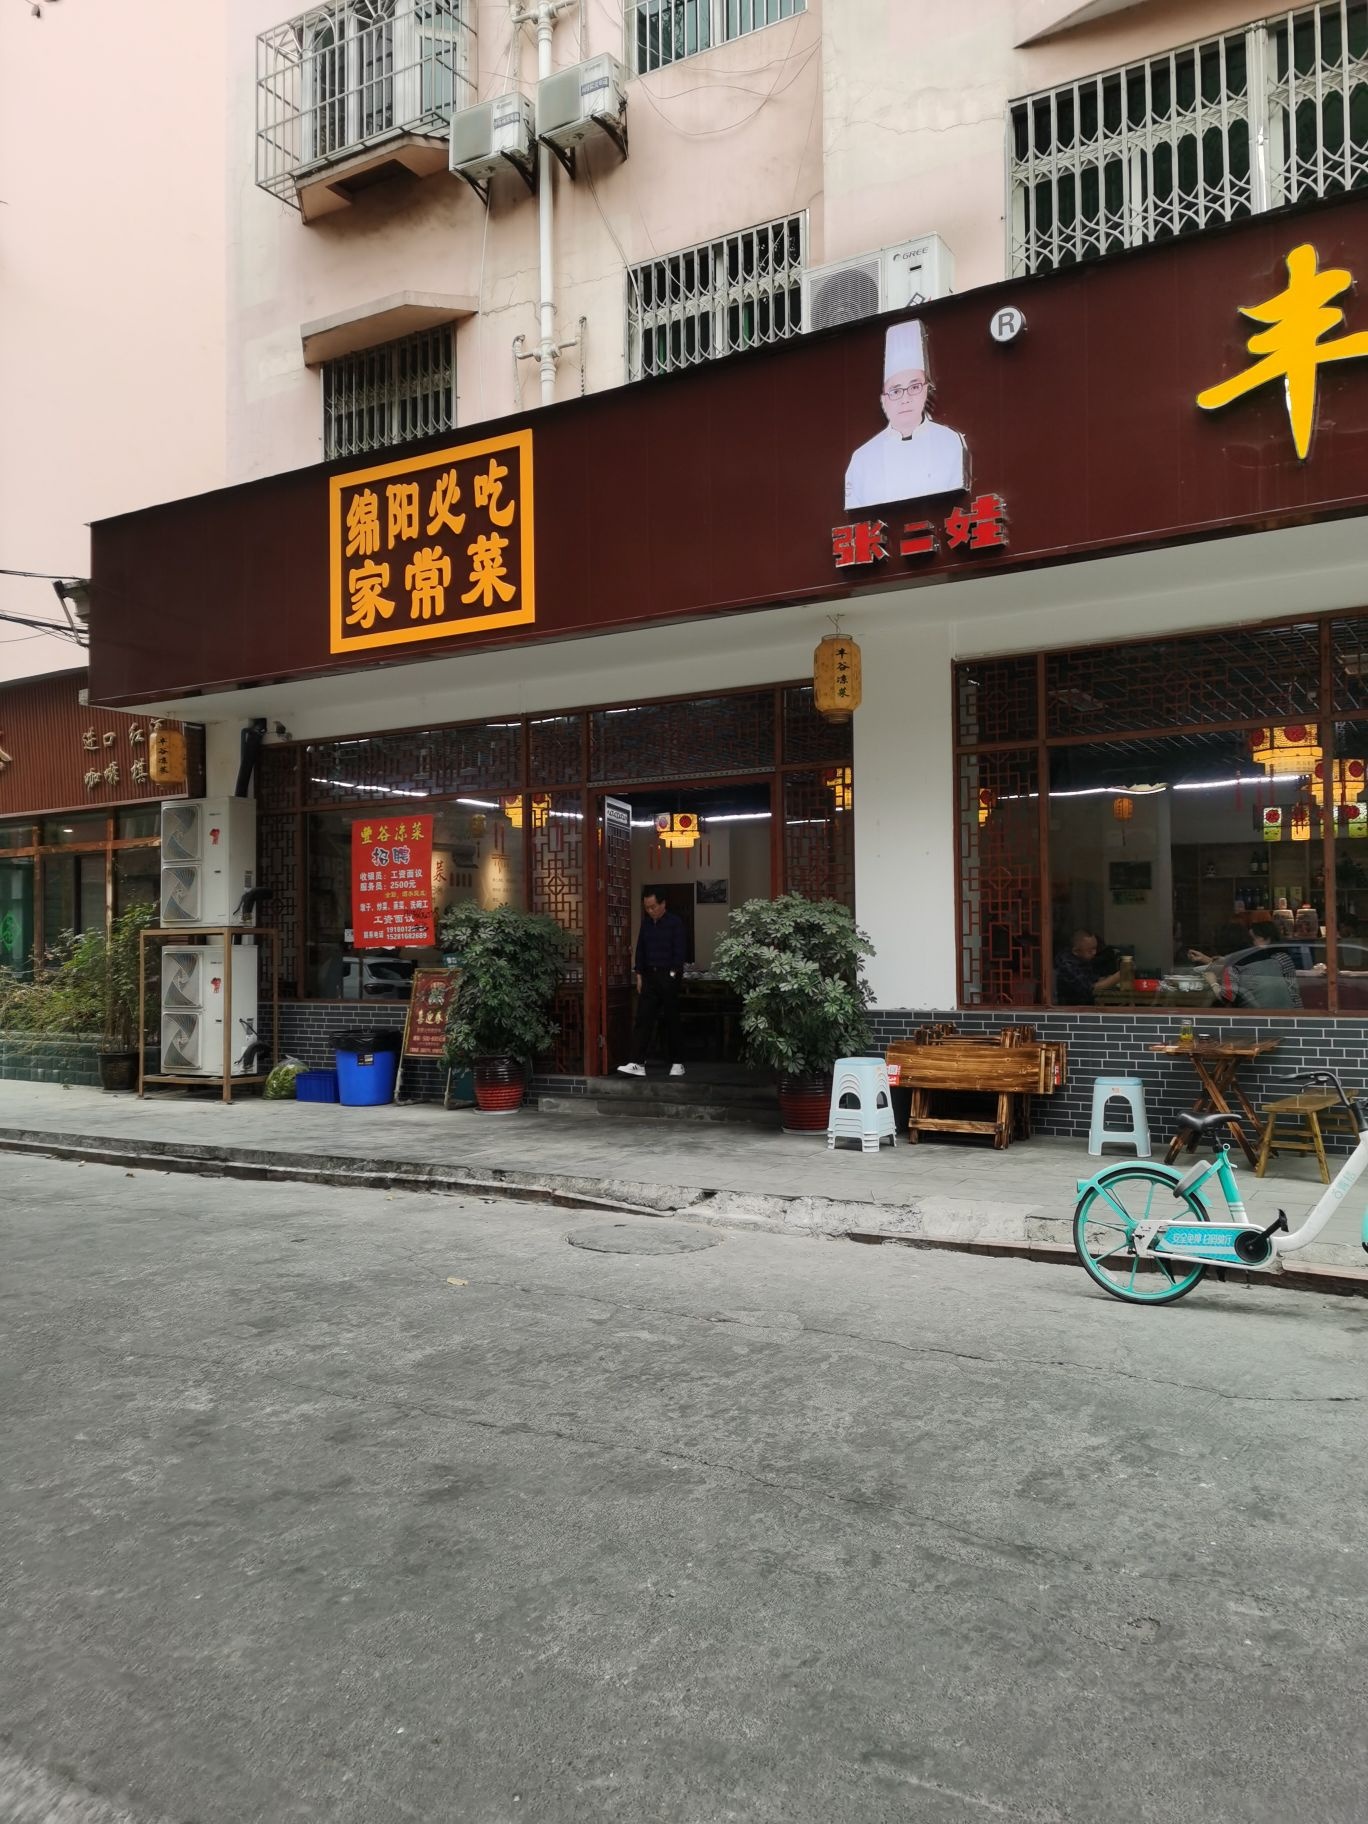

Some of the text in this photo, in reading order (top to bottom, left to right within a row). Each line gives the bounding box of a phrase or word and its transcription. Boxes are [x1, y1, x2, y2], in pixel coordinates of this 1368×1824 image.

[902, 247, 929, 260] GREE
[1196, 243, 1368, 460] 丰
[345, 458, 516, 558] 绵阳必吃
[832, 493, 1010, 568] 张二娃
[345, 531, 517, 629] 家常菜
[371, 845, 411, 867] 招聘
[373, 914, 416, 925] 工资面议
